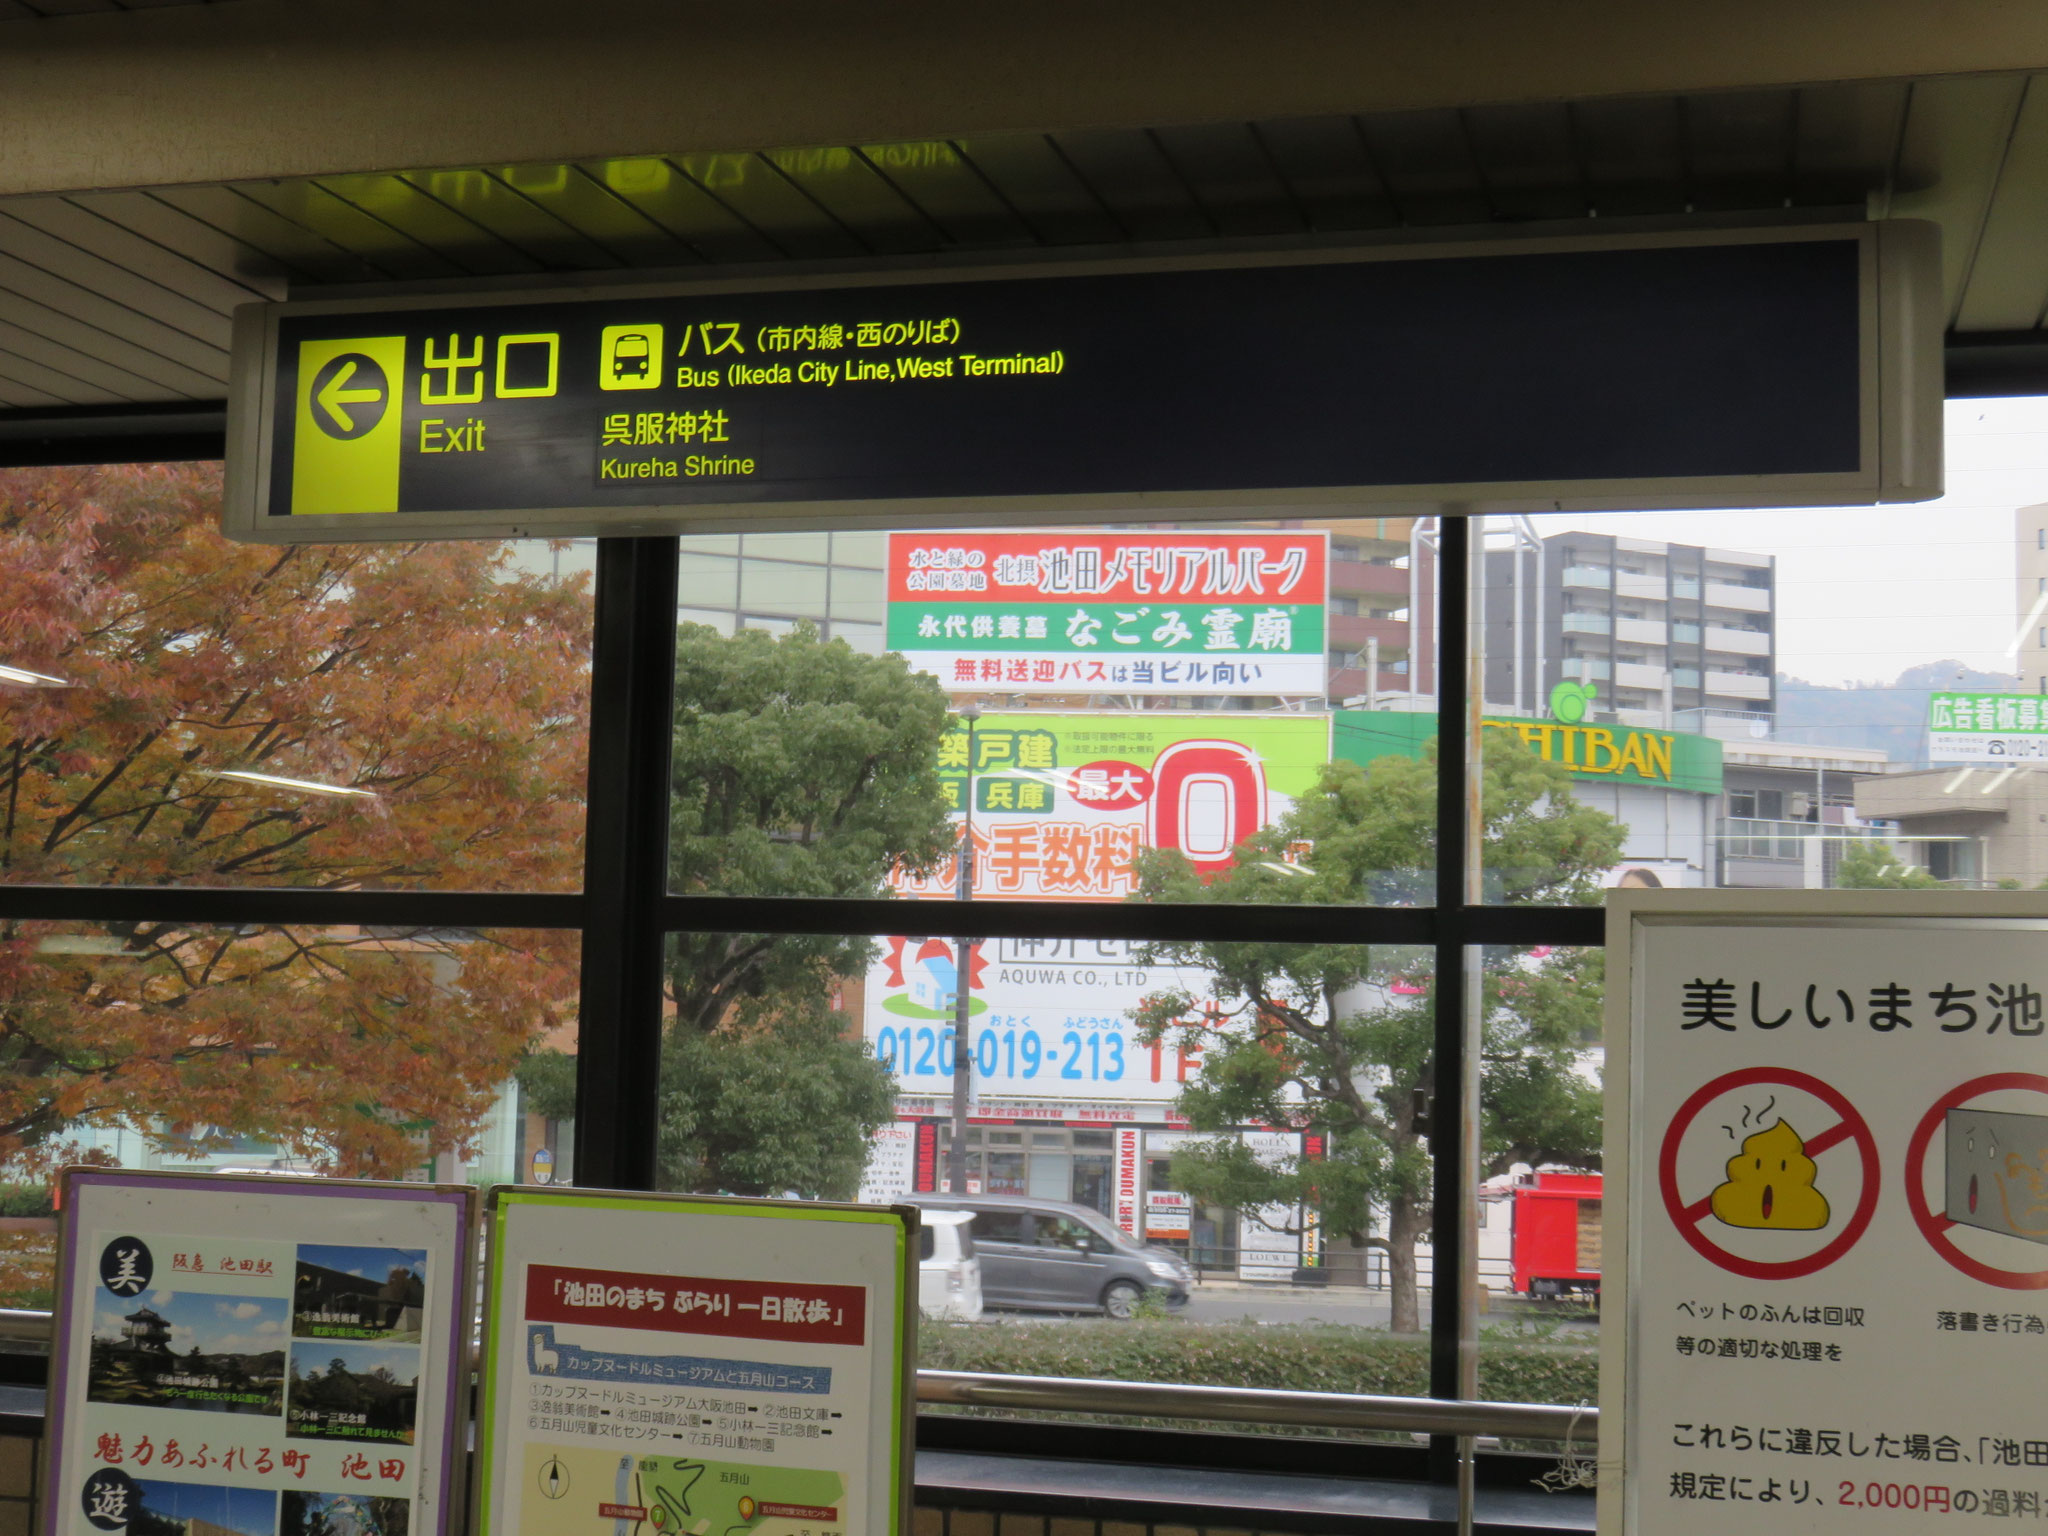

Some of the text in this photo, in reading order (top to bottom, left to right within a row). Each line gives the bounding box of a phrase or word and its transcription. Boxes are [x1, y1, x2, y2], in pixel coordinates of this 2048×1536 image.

[678, 318, 961, 357] バス （市内線・西のりば）
[420, 333, 560, 405] 出口
[677, 366, 719, 388] Bus
[728, 362, 791, 387] (Ikeda
[798, 361, 839, 387] City
[960, 351, 1064, 377] Terminal)
[420, 418, 486, 453] Exit
[601, 409, 730, 446] 呉服神社
[600, 455, 755, 480] Kureha Shrine
[909, 549, 985, 568] 水と緑の
[994, 547, 1308, 595] 北摂 池田メモリアルパーク
[907, 571, 986, 591] 公園墓地
[918, 614, 1049, 640] 永代供養墓
[1065, 607, 1293, 651] なごみ霊廟
[954, 657, 1263, 685] 無料送迎バスは当ビル向い
[986, 781, 1046, 810] 兵庫
[1074, 769, 1144, 802] 最大
[1149, 738, 1268, 884] 0
[999, 968, 1148, 988] AQUWA CO., LTD
[989, 1014, 1124, 1030] おとく ふどうさん
[1681, 977, 2045, 1036] 美しいまち池
[877, 1025, 1125, 1082] 0120-019-213
[107, 1248, 146, 1293] 美
[172, 1252, 274, 1276] 阪急 池田駅
[554, 1278, 844, 1326] 「池田のまち ぶらり 一日散歩」
[1676, 1301, 1865, 1328] ペットのふんは回収
[1675, 1335, 1843, 1362] 等の適切な処理を
[566, 1355, 816, 1391] カップヌードルミュージアムと五月山コース
[94, 1432, 406, 1482] 魅力あふれる町 池田
[1672, 1423, 2048, 1467] これらに違反した場合、「池田
[719, 1471, 750, 1486] 五月山
[1669, 1472, 2048, 1520] 規定により、2,000円の過料
